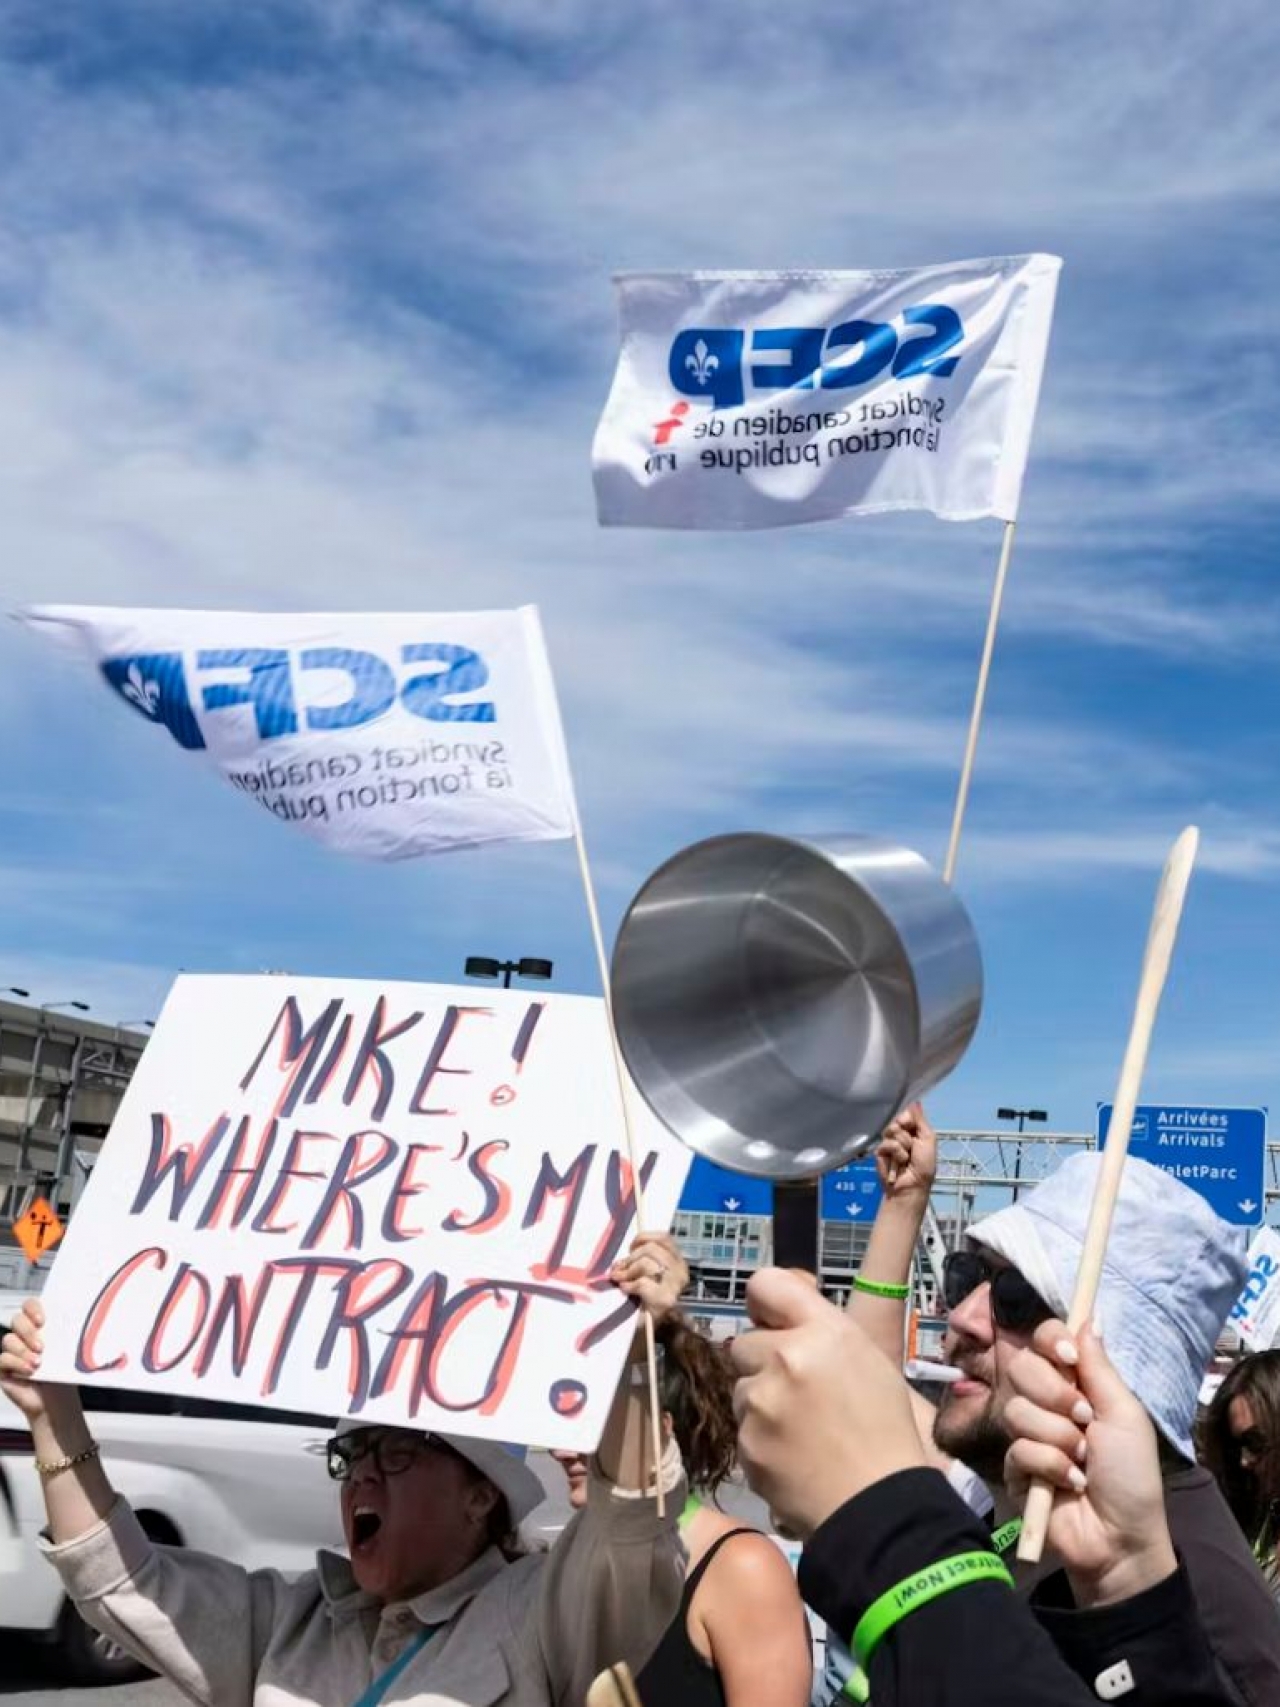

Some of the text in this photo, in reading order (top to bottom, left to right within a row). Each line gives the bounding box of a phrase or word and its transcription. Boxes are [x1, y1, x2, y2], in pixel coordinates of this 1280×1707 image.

[240, 994, 547, 1122] MIKE!
[1157, 1110, 1229, 1127] Arrivées
[1158, 1132, 1226, 1148] Arrivals
[130, 1110, 658, 1283] WHERE'S MY
[75, 1246, 642, 1418] CONTRACT?
[893, 1571, 946, 1610] Now!
